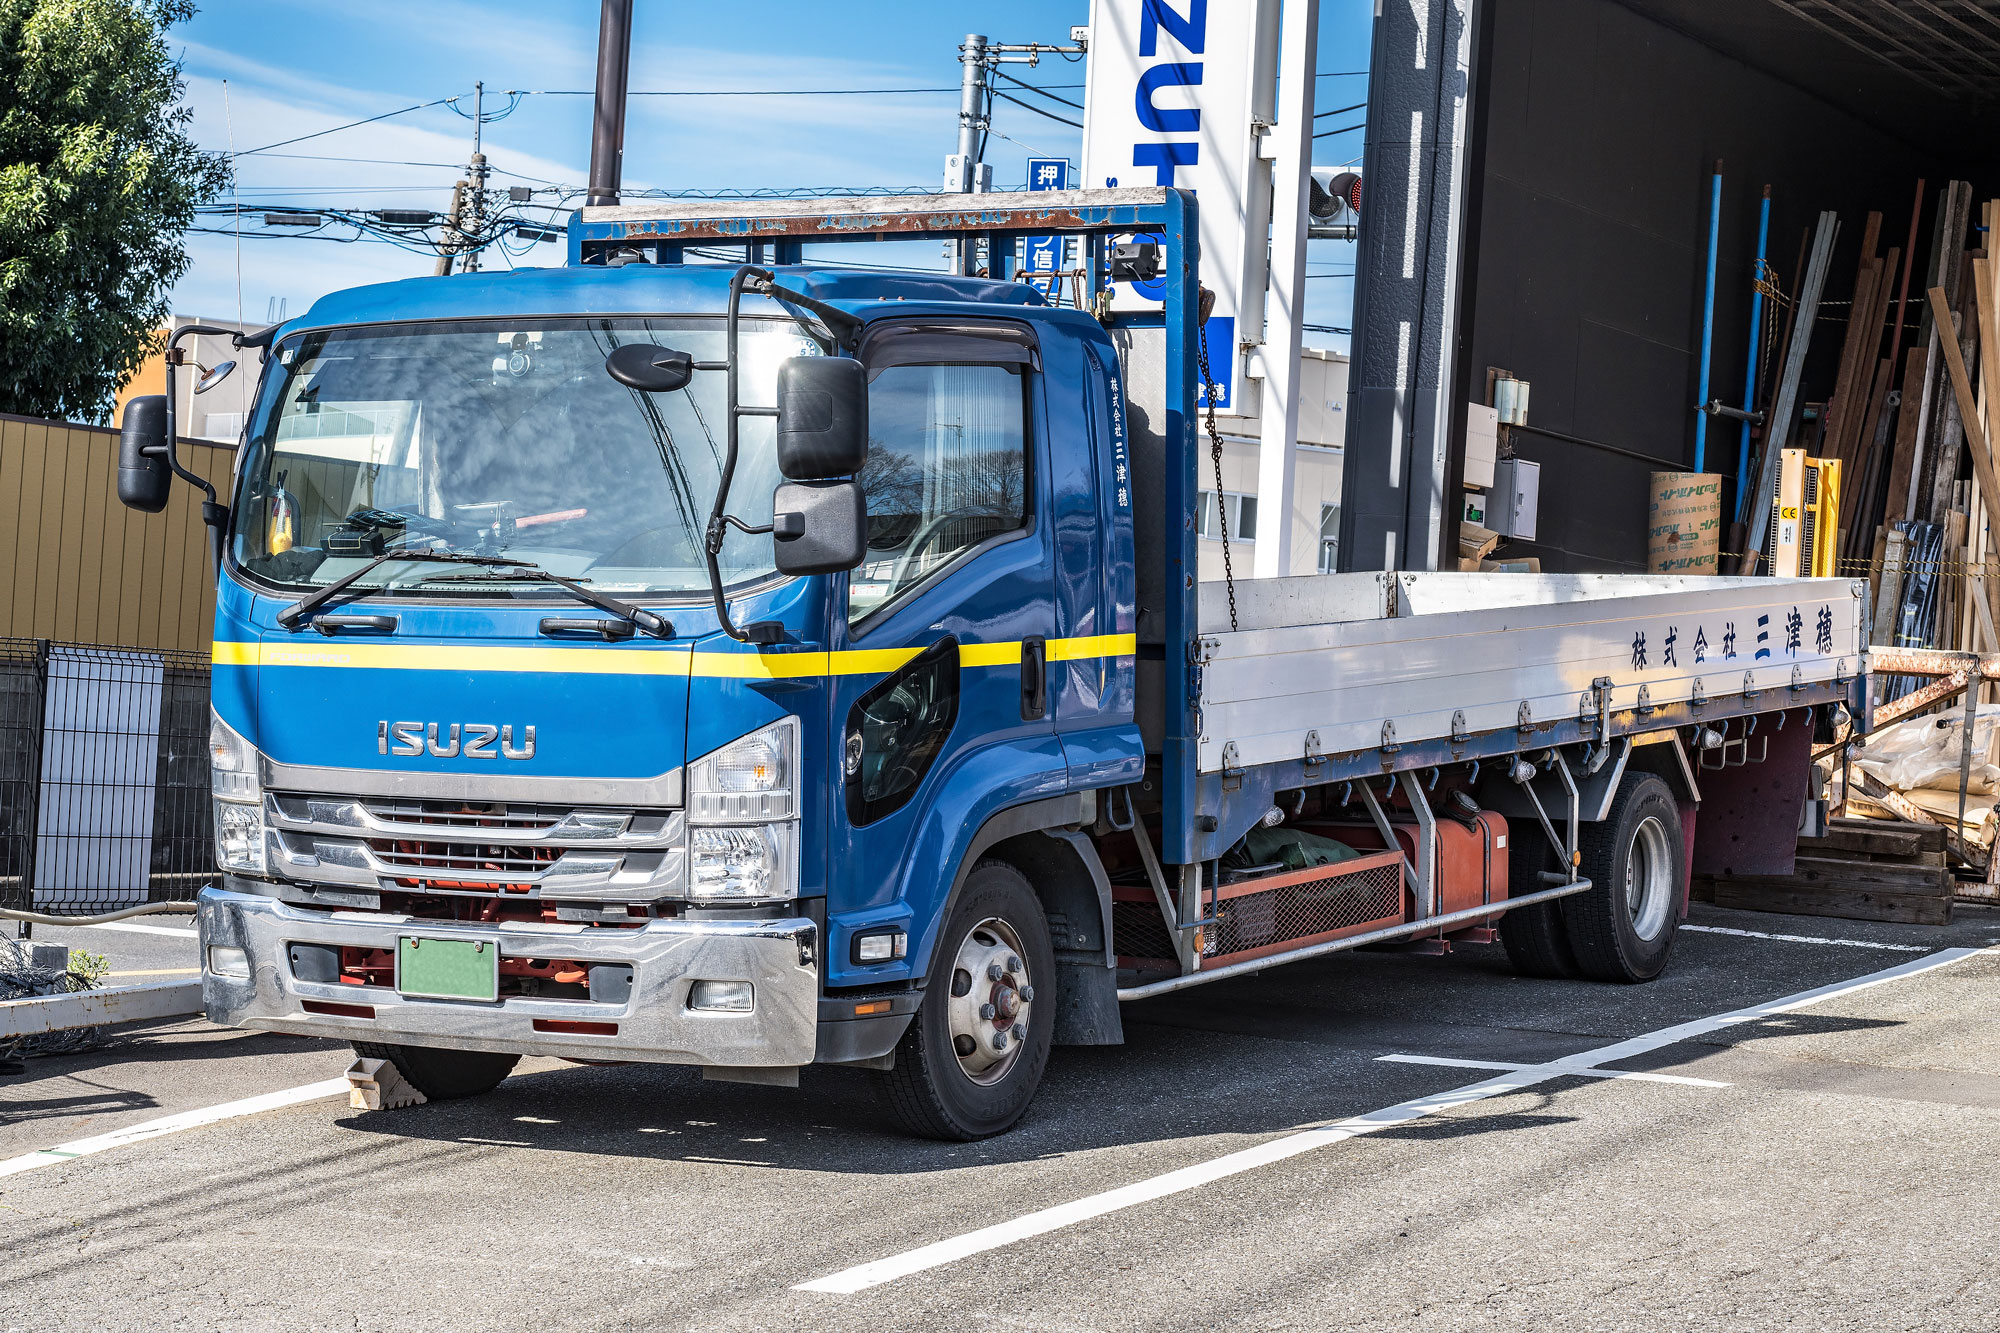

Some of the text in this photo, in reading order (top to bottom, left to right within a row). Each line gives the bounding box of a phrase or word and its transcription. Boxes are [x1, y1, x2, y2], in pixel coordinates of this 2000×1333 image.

[1781, 507, 1797, 519] CE
[1631, 604, 1833, 672] 株式会社三津穂
[269, 652, 351, 664] FORWARD
[377, 720, 537, 761] ISUZU
